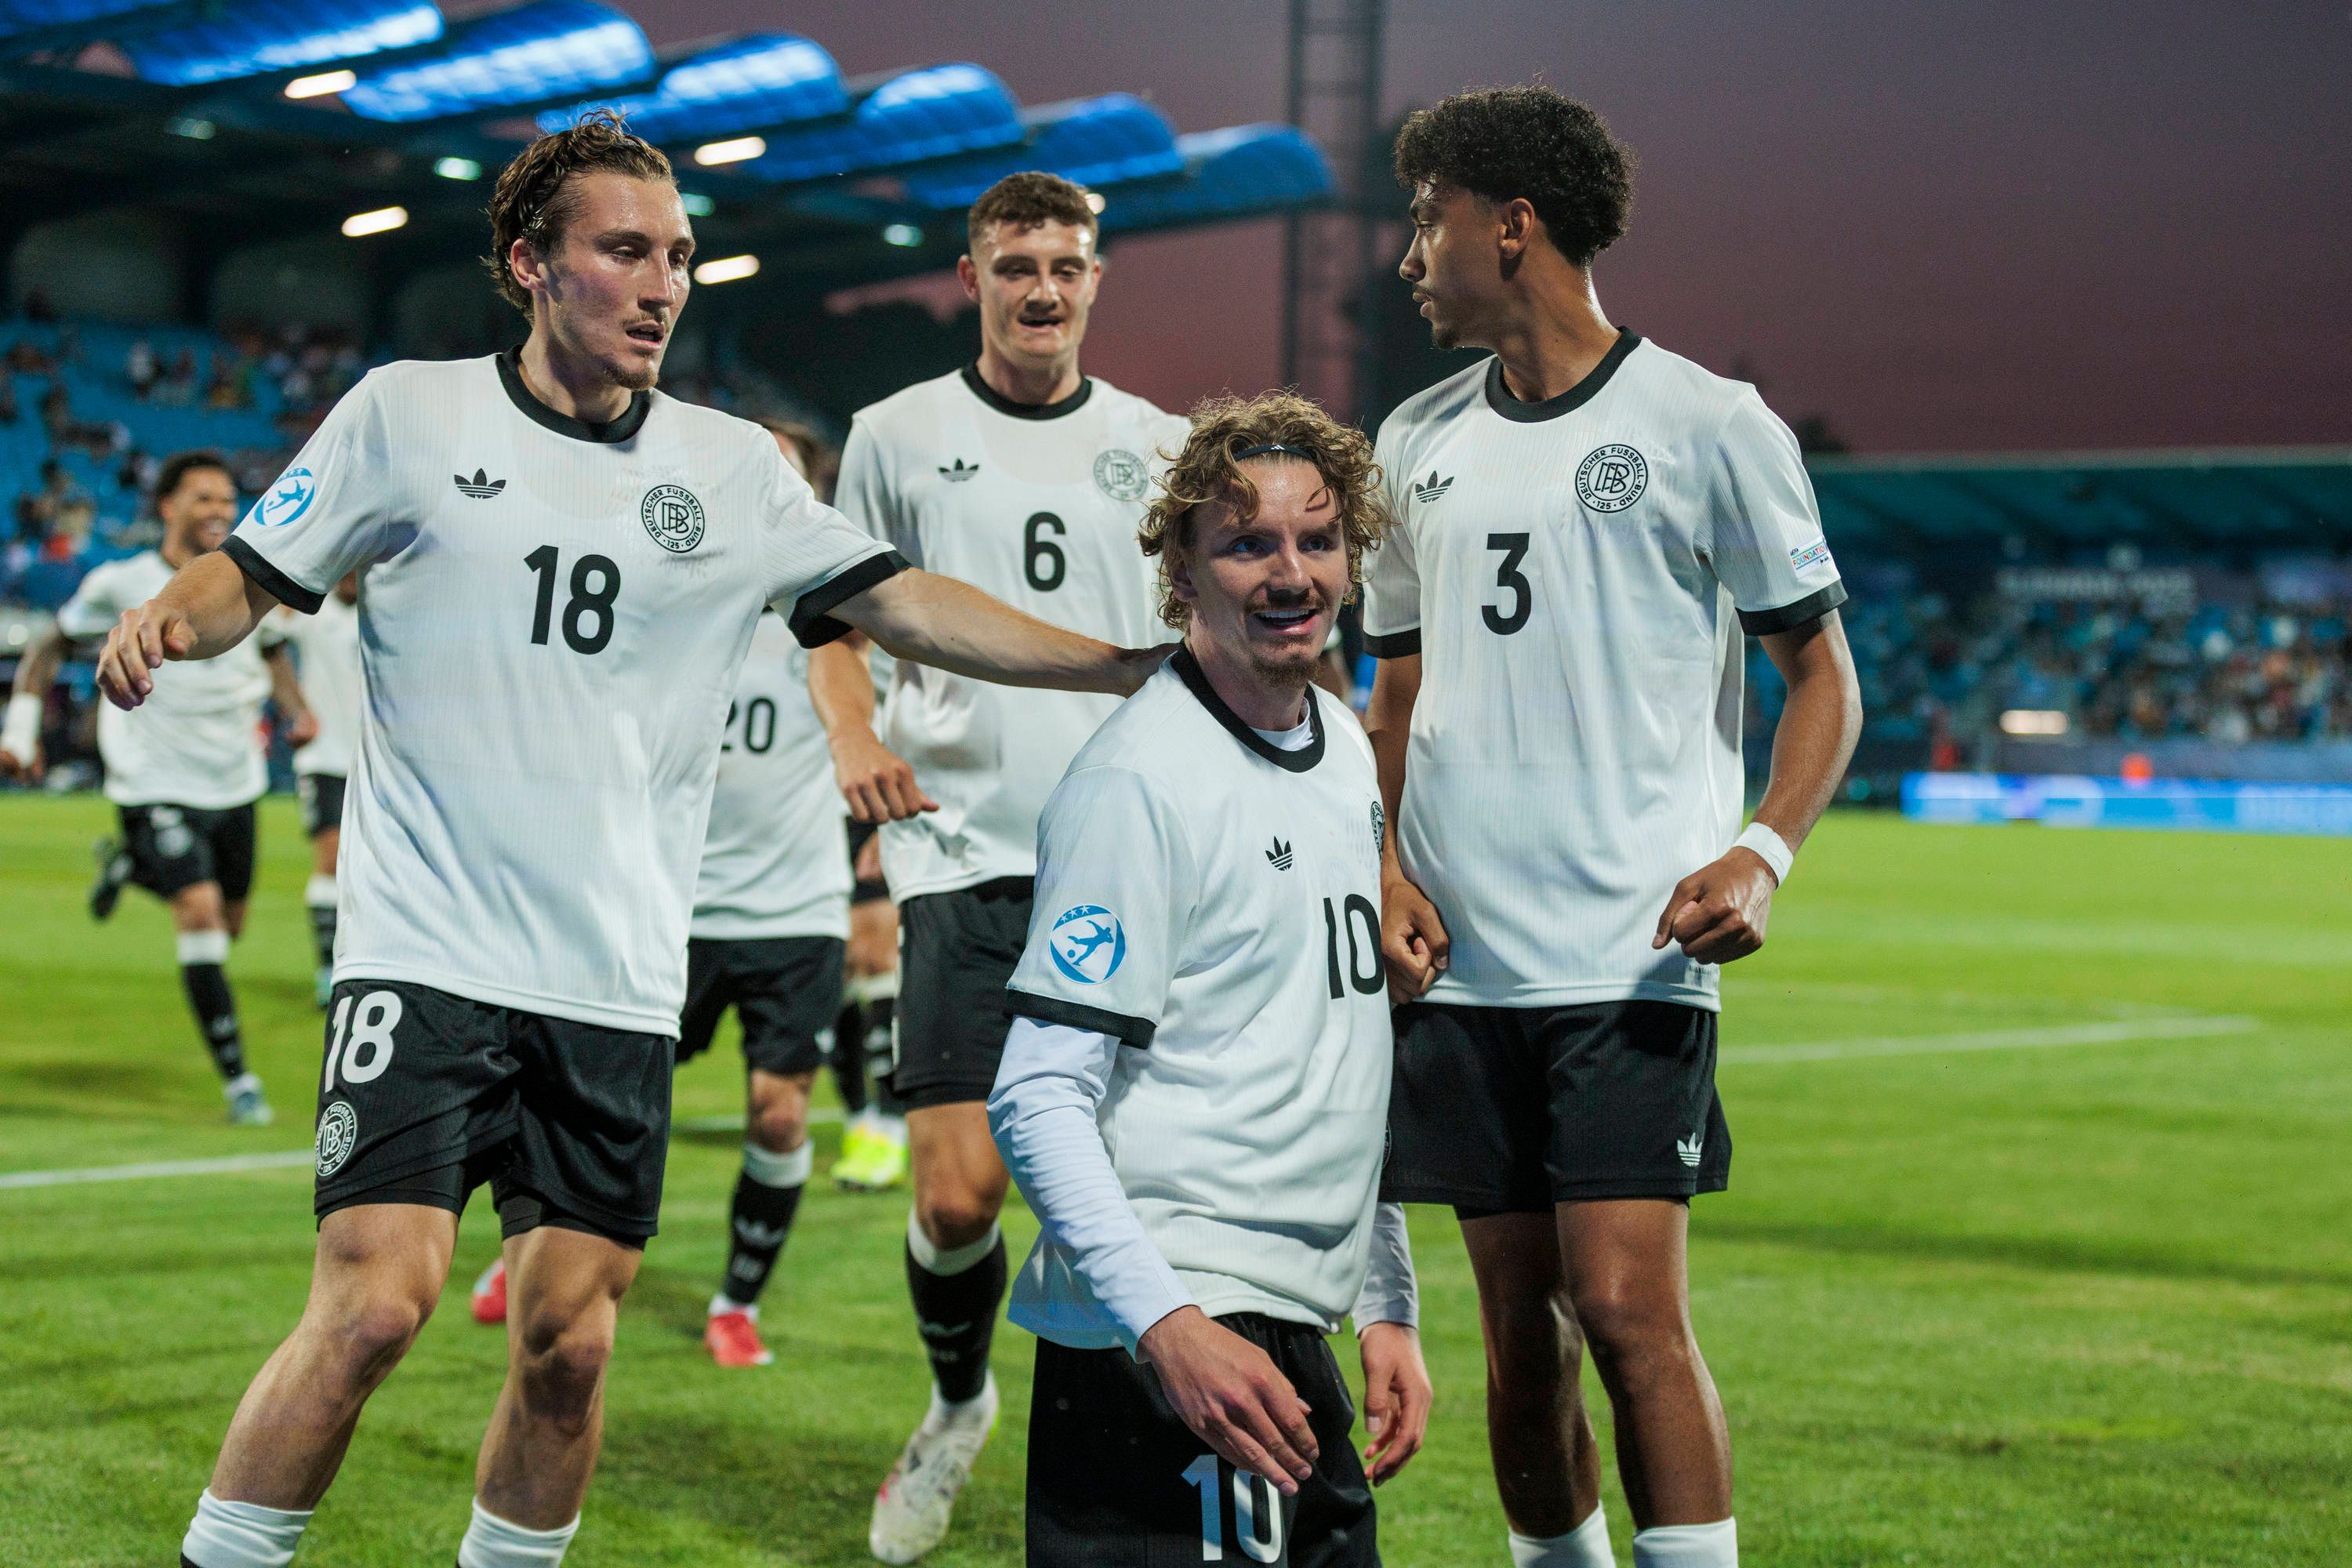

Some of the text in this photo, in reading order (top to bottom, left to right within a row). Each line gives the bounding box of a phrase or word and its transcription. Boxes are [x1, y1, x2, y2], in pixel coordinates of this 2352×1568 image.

[644, 489, 664, 539] DEUTSCHER
[1579, 449, 1606, 500] DEUTSCHER
[1596, 500, 1611, 510] 125
[667, 539, 680, 549] 125
[1025, 511, 1065, 592] 6
[1481, 532, 1532, 636] 3
[1792, 545, 1826, 568] FOUNDATIO
[523, 544, 621, 655] 18
[1323, 893, 1385, 1000] 10
[325, 990, 403, 1094] 18
[1181, 1454, 1283, 1564] 10
